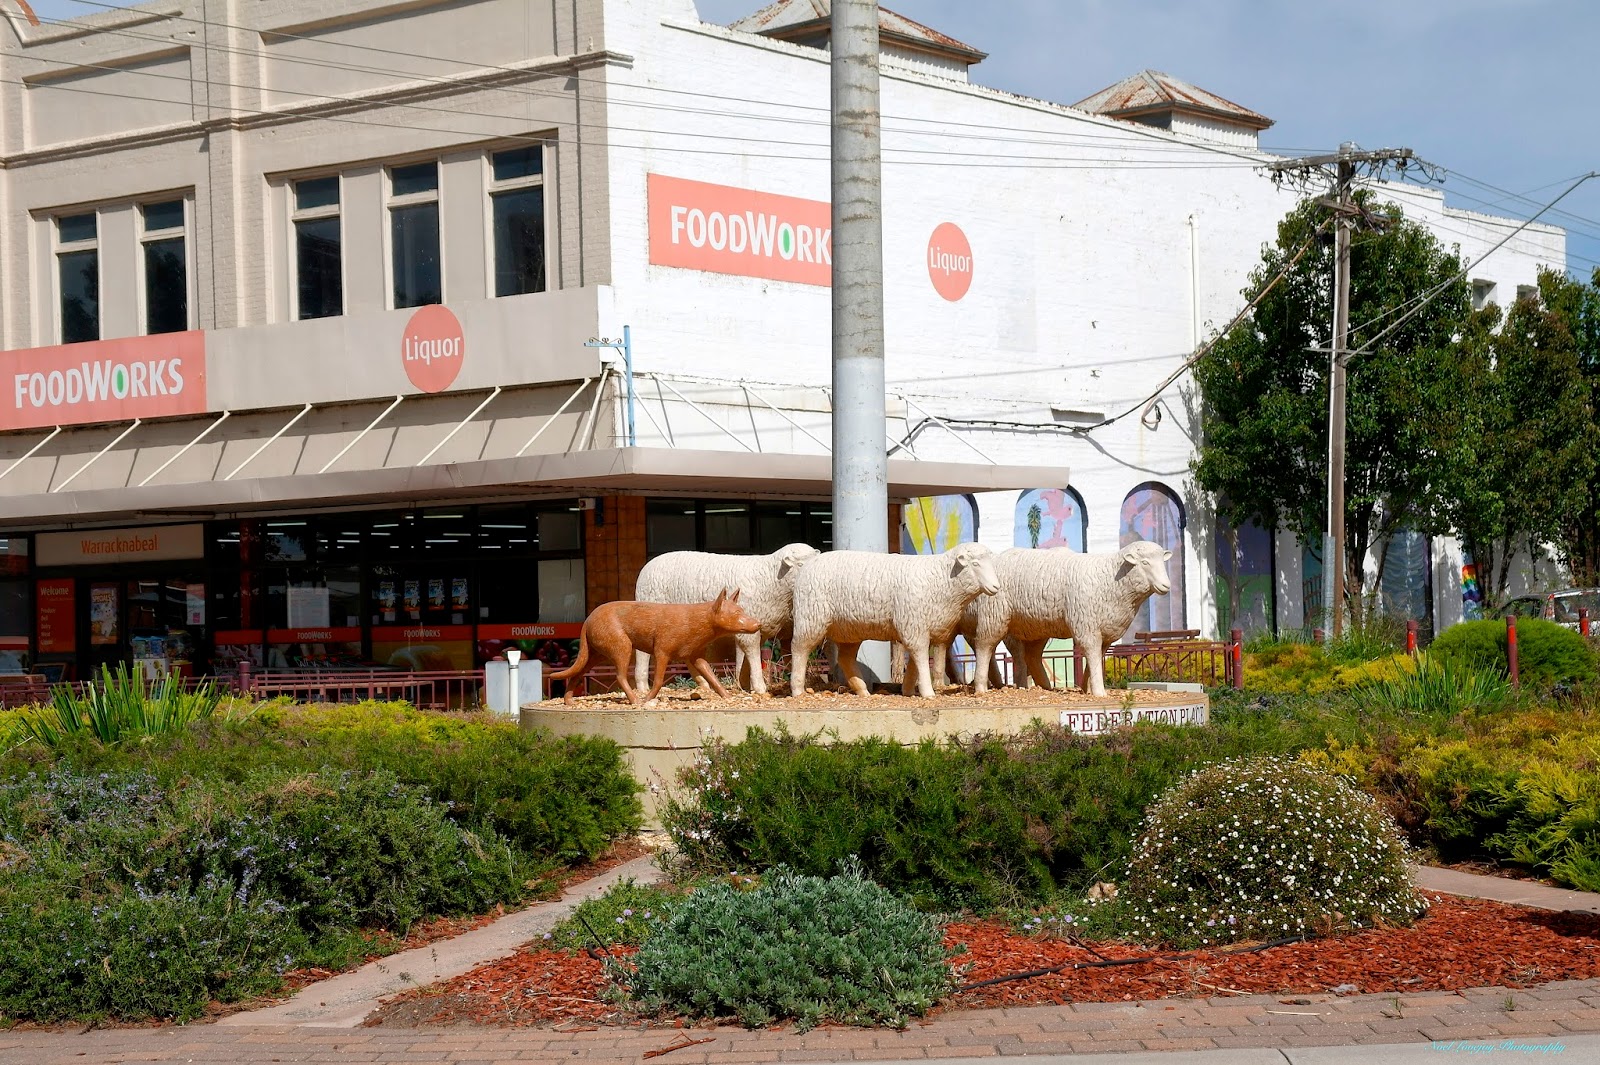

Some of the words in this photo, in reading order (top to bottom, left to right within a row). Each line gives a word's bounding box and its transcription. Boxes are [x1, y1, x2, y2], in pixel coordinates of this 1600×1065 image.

[670, 205, 832, 265] FOODWORK
[930, 246, 971, 275] Liquor
[405, 335, 461, 366] Liquor
[14, 357, 184, 408] FOODWORKS
[81, 534, 158, 554] Warracknabeal
[40, 586, 69, 596] Welcome
[297, 631, 332, 640] FOODWORKS
[403, 629, 441, 638] FOODWORKS
[511, 626, 555, 636] FOODWORKS
